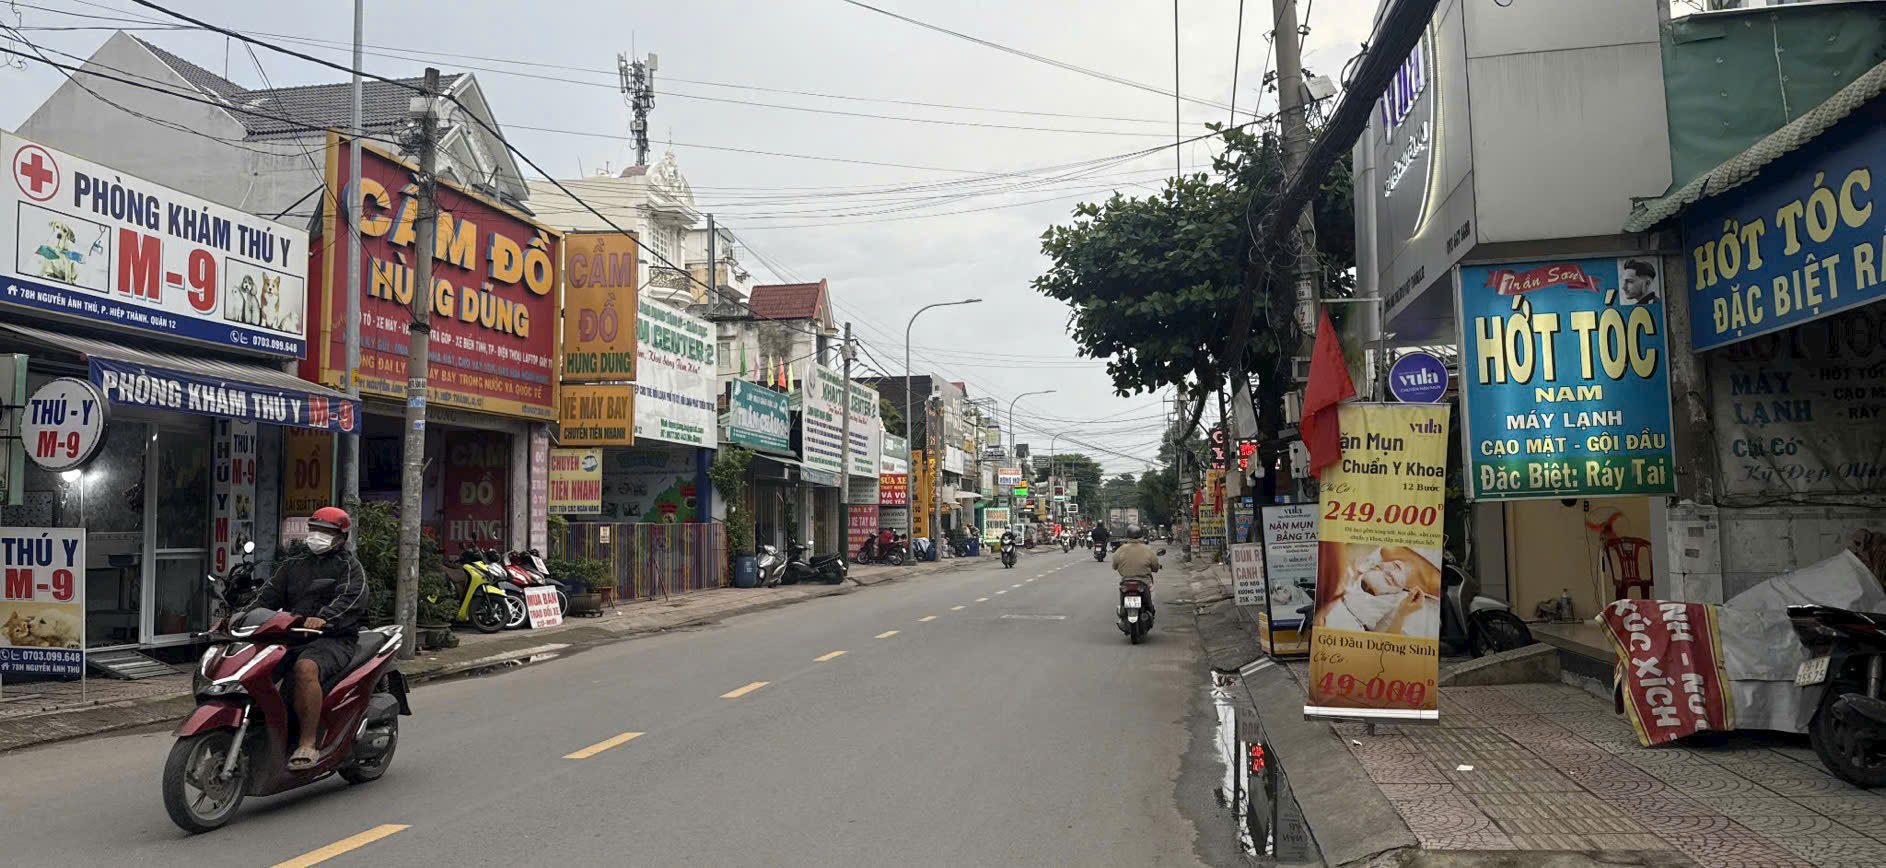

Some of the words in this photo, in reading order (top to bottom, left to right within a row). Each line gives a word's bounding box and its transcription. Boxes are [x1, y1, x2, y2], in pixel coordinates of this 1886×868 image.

[74, 171, 160, 231] PHÒNG
[168, 202, 231, 251] KHÁM
[237, 225, 273, 264] THÚ
[280, 237, 291, 268] Y
[1693, 218, 1765, 290] HỚT
[1776, 168, 1873, 256] TÓC
[117, 227, 218, 313] M-9
[485, 228, 554, 296] ĐỒ
[369, 251, 455, 318] HÙG
[461, 280, 530, 338] DŨNG
[1502, 272, 1541, 291] Trần
[1713, 283, 1764, 337] ĐẶC
[1772, 252, 1840, 317] BIỆT
[20, 288, 35, 300] 78H
[37, 291, 66, 307] NGUYỄN
[67, 296, 82, 309] ẢNH
[109, 307, 125, 319] HIỆP
[150, 315, 168, 329] QUẬN
[169, 319, 177, 329] 12
[579, 292, 619, 342] ĐỒ
[376, 315, 385, 329] XE
[385, 315, 398, 332] MÁY
[456, 335, 463, 348] XE
[652, 323, 704, 363] CENTER
[704, 343, 715, 365] 2
[1475, 294, 1559, 385] HỚT
[1570, 288, 1657, 380] TÓC
[378, 357, 393, 375] ĐẠI
[441, 369, 456, 384] BAY
[566, 346, 597, 374] HÙNG
[600, 346, 631, 374] DŨNG
[1399, 367, 1439, 386] vula
[102, 368, 182, 407] PHÒNG
[187, 381, 247, 417] KHÁM
[251, 391, 287, 422] THÚ
[290, 399, 301, 424] Y
[308, 394, 355, 432] M-9
[563, 391, 577, 420] VÉ
[580, 391, 604, 420] MÁY
[607, 396, 629, 420] BAY
[1535, 384, 1604, 403] NAM
[31, 393, 67, 425] THÚ
[82, 400, 94, 425] Y
[1506, 409, 1555, 430] MÁY
[1563, 410, 1623, 431] LẠNH
[604, 426, 625, 440] NHANH
[1410, 418, 1443, 434] vula
[36, 431, 80, 459] M-9
[234, 431, 249, 454] THÚ
[250, 435, 256, 454] Y
[1340, 432, 1361, 454] ặn
[1366, 433, 1404, 456] Mụn
[1481, 440, 1520, 458] CẠO
[1526, 435, 1567, 458] MẶT
[1586, 431, 1619, 454] GỘI
[1626, 427, 1666, 450] ĐẦU
[232, 458, 256, 486] M-9
[551, 450, 580, 472] CHUYỂN
[1342, 457, 1388, 475] Chuẩn
[1392, 461, 1402, 476] Y
[1406, 461, 1444, 478] Khoa
[571, 479, 600, 501] NHANH
[880, 474, 895, 485] SỬA
[897, 476, 908, 485] XE
[1402, 483, 1414, 491] 12
[1416, 483, 1441, 492] Bước
[1480, 464, 1521, 495] Đặc
[1528, 462, 1578, 493] Biệt:
[1585, 459, 1625, 491] Ráy
[1631, 457, 1666, 486] Tai
[450, 514, 503, 542] HÙNG
[1269, 521, 1289, 533] NẶN
[1291, 520, 1315, 532] MỤN
[1276, 531, 1302, 541] BẰNG
[1, 532, 52, 567] THÚ
[62, 538, 80, 567] Y
[4, 568, 75, 602] M-9
[1236, 566, 1258, 580] CANH
[526, 593, 543, 607] MUA
[553, 606, 561, 616] XE
[22, 650, 81, 662] 0703.099.648
[1318, 633, 1337, 648] Gội
[1340, 636, 1363, 650] Đầu
[1367, 639, 1407, 657] Dưỡng
[1409, 644, 1437, 657] Sinh
[25, 662, 51, 672] NGUYỄN
[52, 662, 66, 673] ẢNH
[1631, 656, 1682, 727] XÍCH
